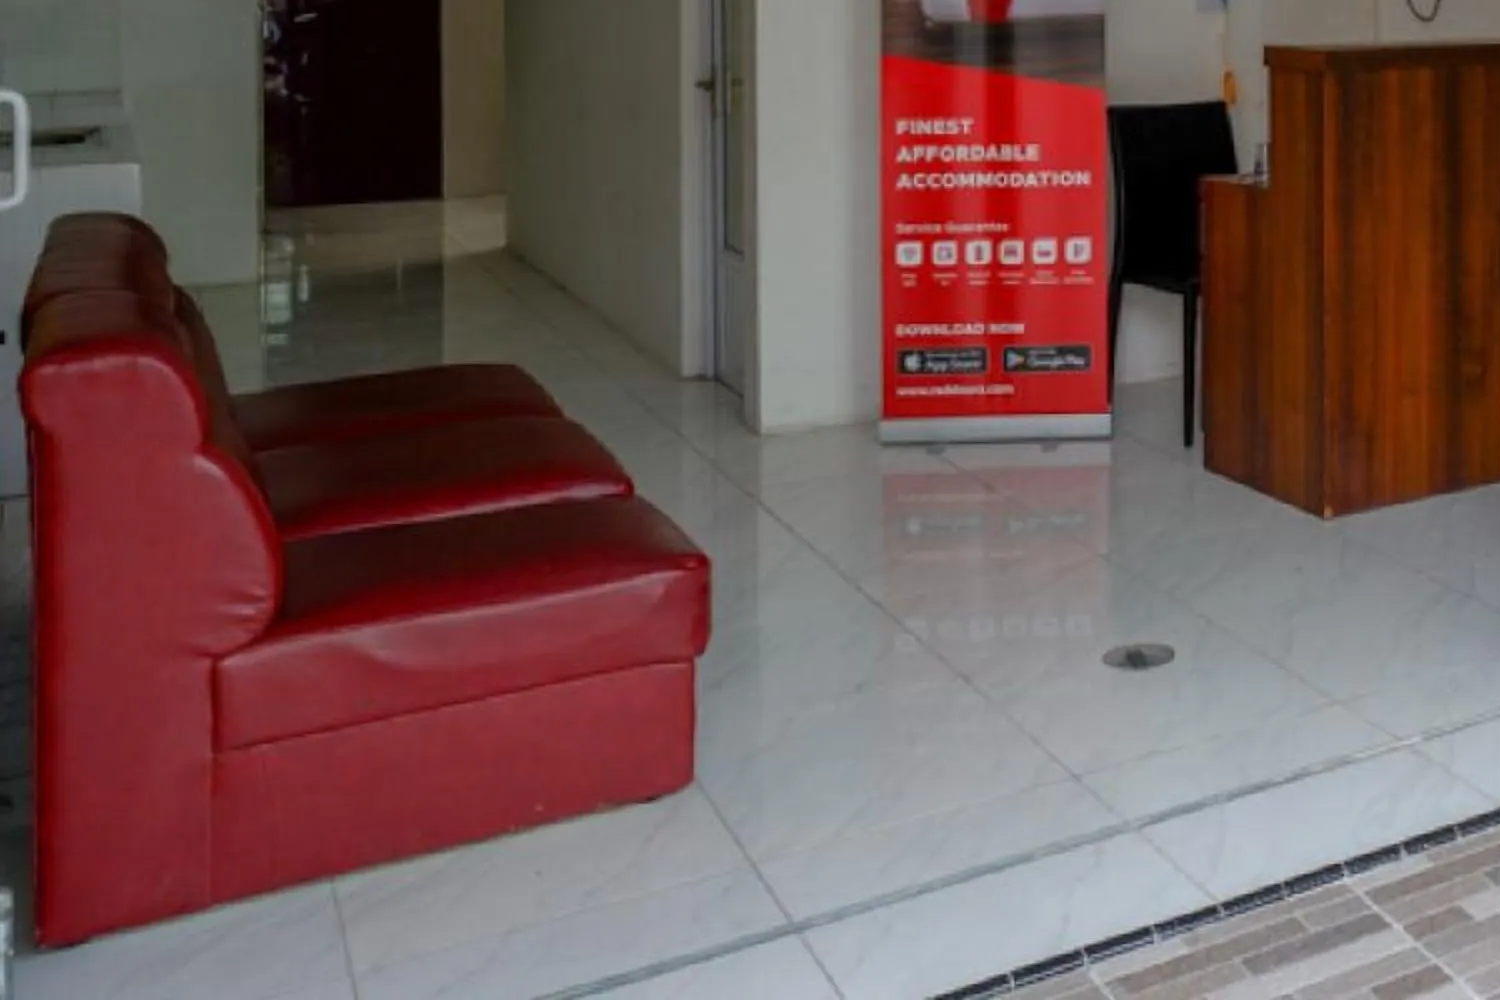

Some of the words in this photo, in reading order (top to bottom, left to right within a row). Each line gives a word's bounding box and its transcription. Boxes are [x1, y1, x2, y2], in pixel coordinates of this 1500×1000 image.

[896, 118, 974, 135] FINEST
[896, 144, 1040, 163] AFFORDABLE
[896, 170, 1092, 189] ACCOMMODATION
[896, 324, 985, 338] DOWNLOAD
